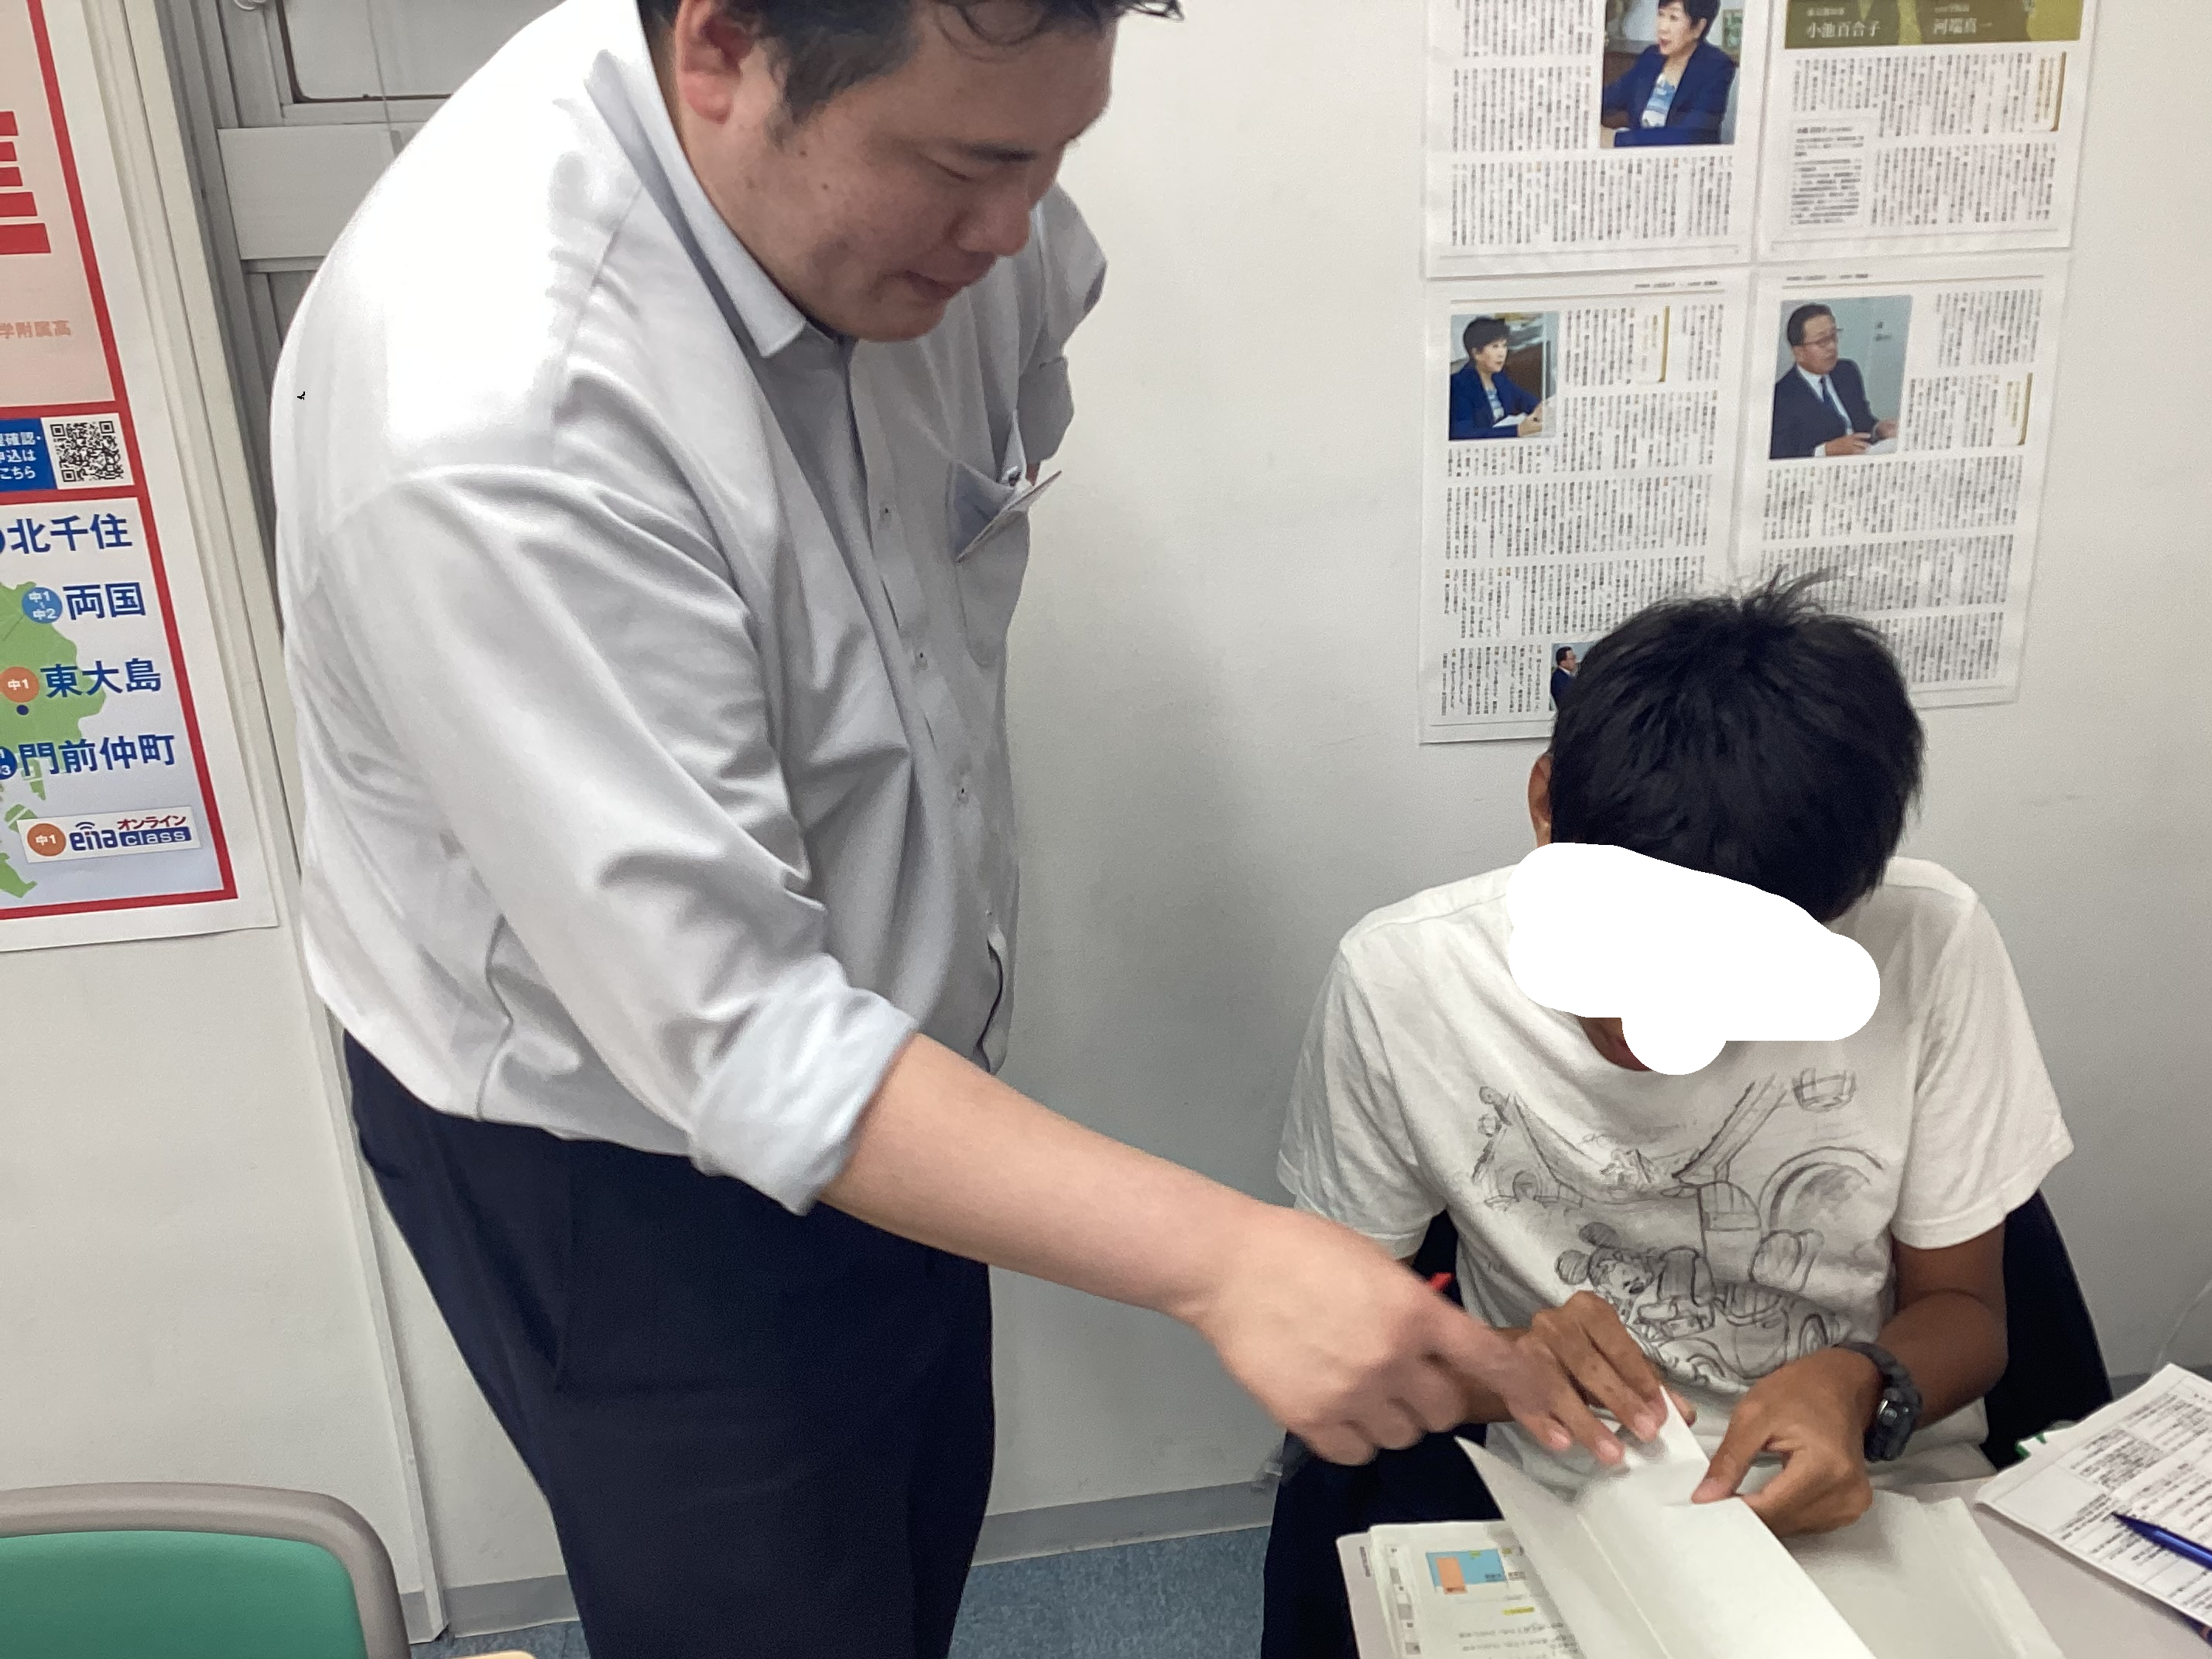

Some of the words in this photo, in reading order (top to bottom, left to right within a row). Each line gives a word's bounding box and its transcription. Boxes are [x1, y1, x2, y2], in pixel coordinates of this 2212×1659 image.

[0, 466, 36, 480] こちら
[7, 513, 132, 554] 北千住
[29, 591, 50, 603] 中1
[63, 582, 146, 620] 両国
[33, 608, 56, 621] 中2
[7, 678, 29, 690] 中1
[40, 658, 161, 698] 東大島
[18, 734, 175, 777] 門前仲町
[117, 815, 187, 831] オンライン
[35, 834, 56, 847] 中1
[70, 829, 118, 851] ena
[125, 830, 187, 847] class
